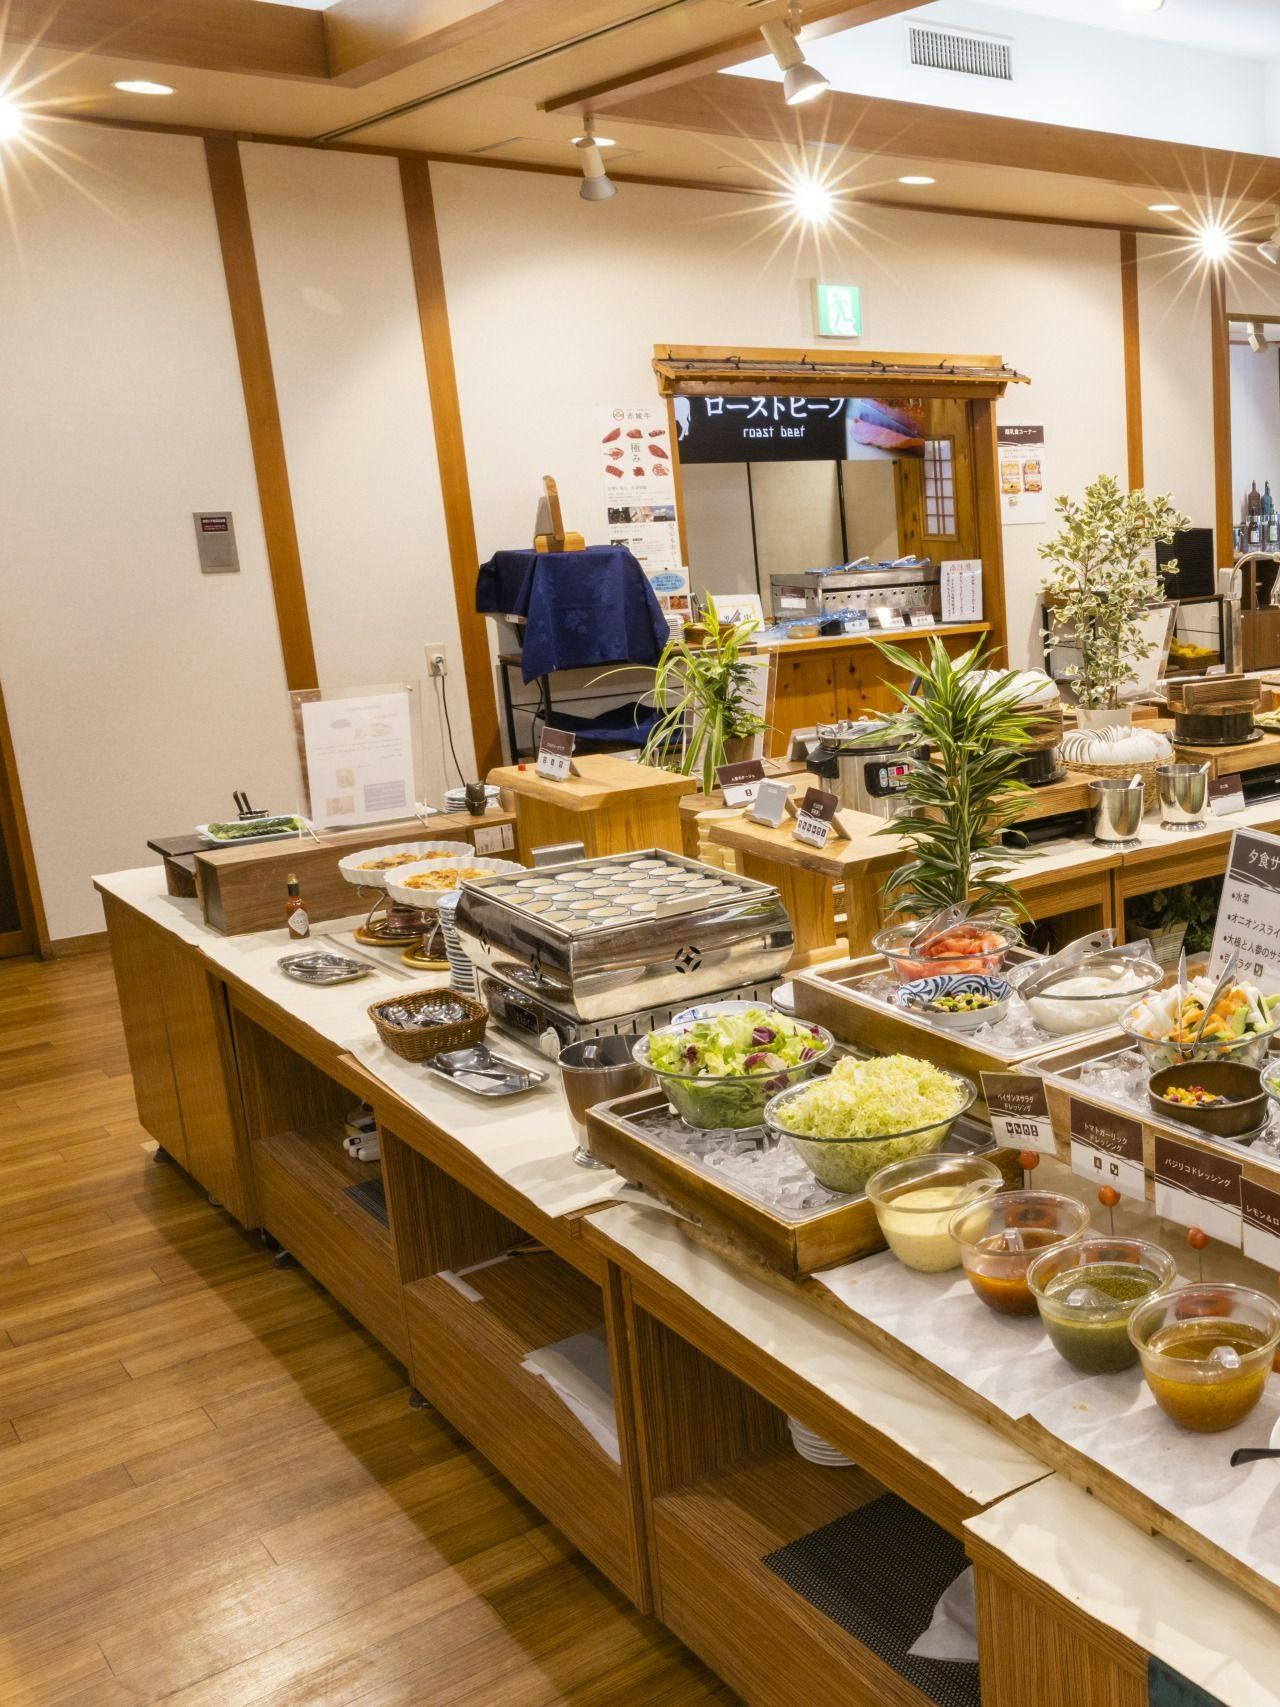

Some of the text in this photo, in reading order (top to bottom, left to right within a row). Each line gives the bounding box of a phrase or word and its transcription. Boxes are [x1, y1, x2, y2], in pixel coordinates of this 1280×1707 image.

[743, 425, 806, 438] roast beef
[1084, 1122, 1127, 1145] トマトガーリック
